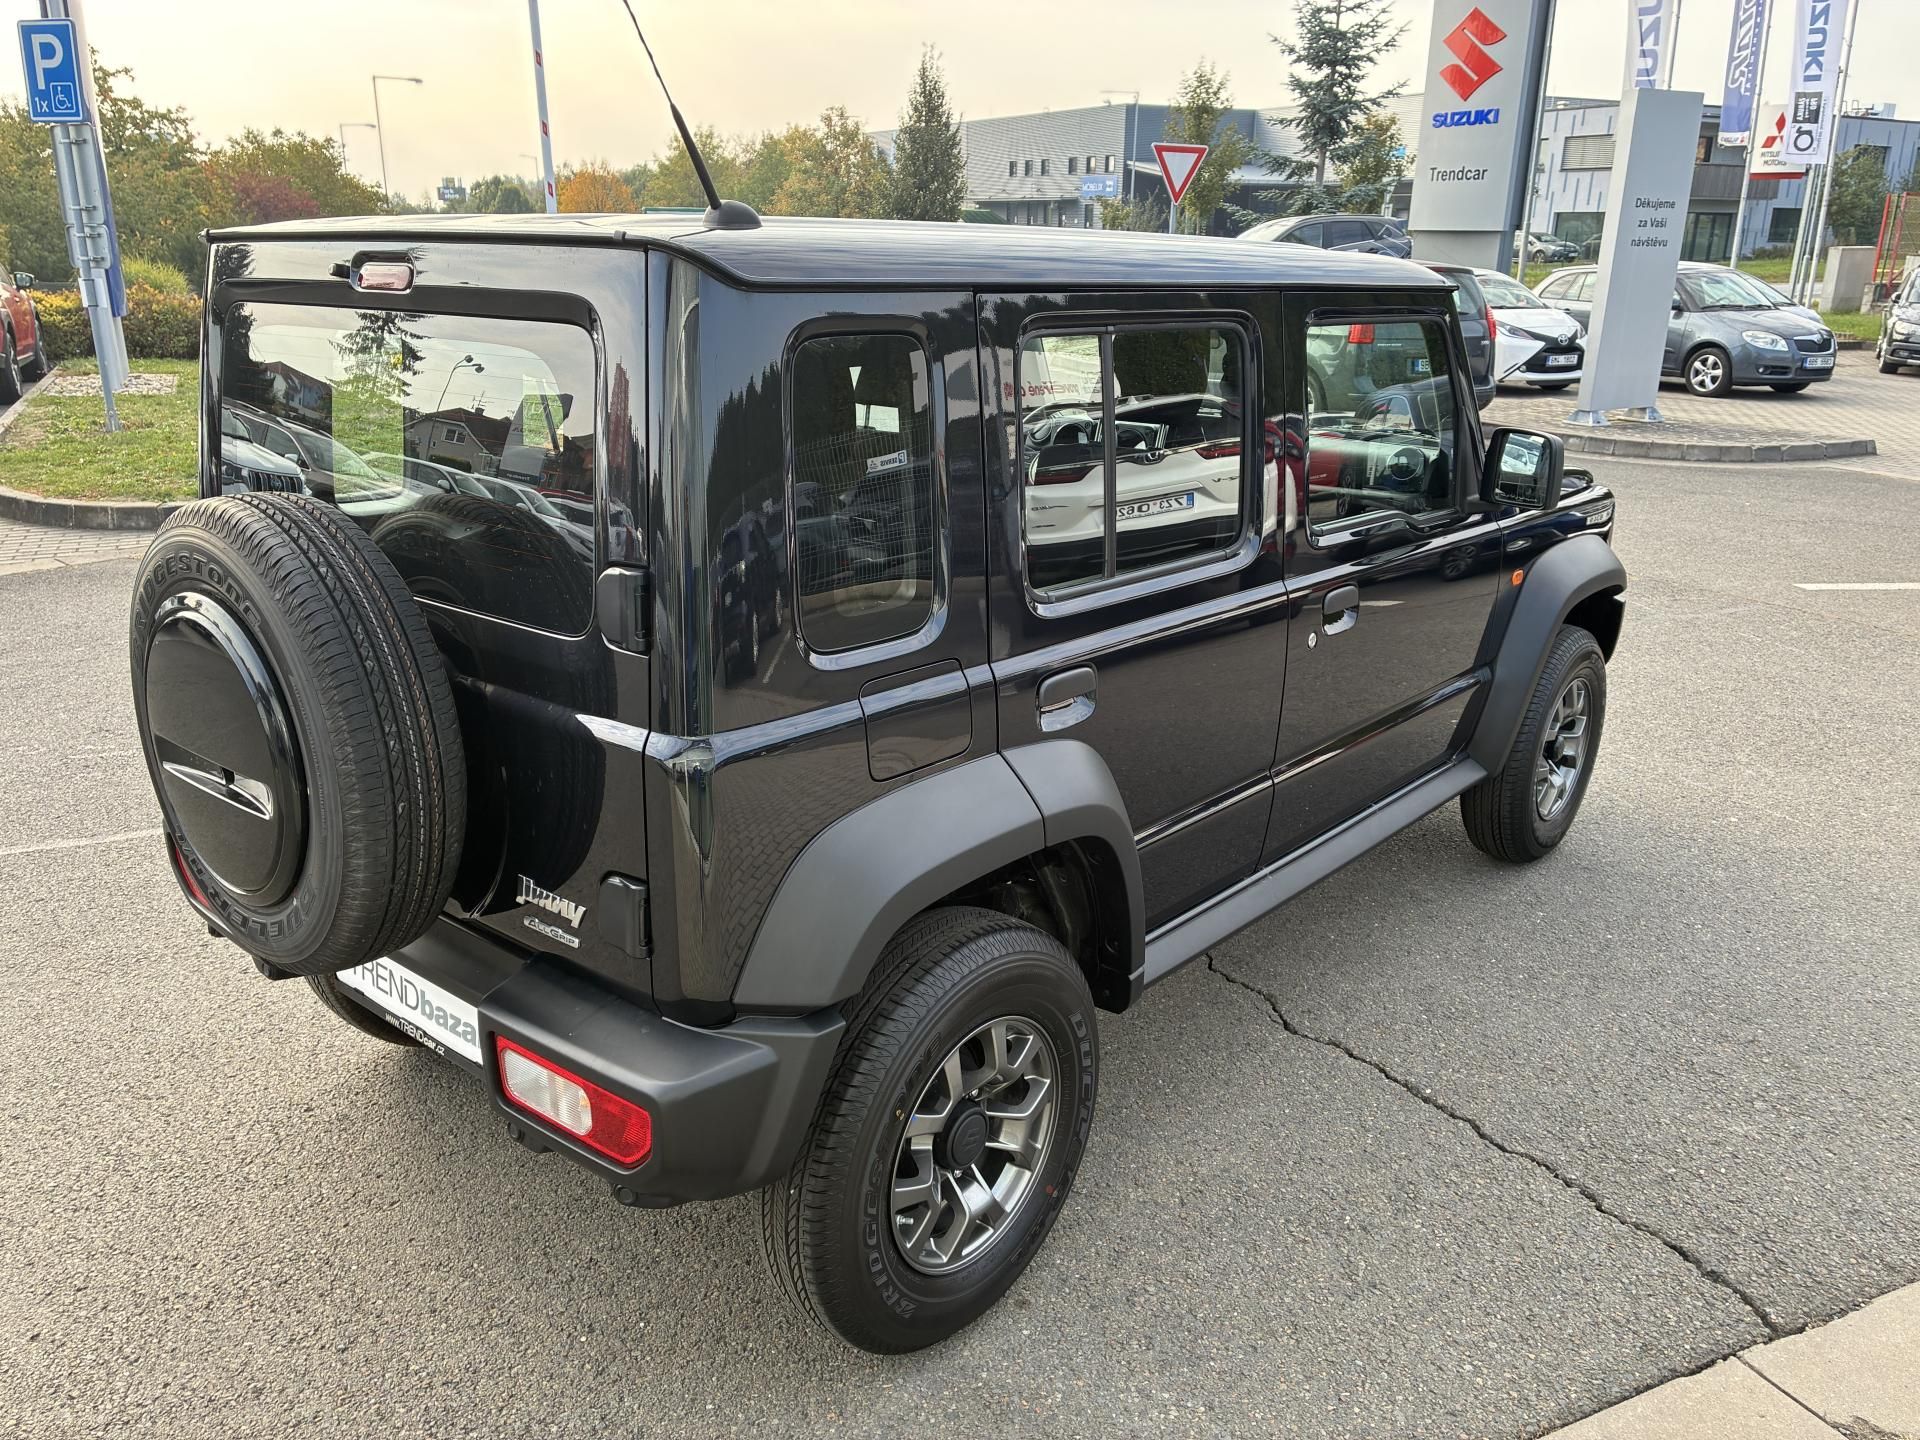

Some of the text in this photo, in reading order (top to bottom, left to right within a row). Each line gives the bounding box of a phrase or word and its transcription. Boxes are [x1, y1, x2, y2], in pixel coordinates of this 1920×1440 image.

[31, 33, 63, 90] P
[35, 97, 49, 112] 1x
[1432, 108, 1500, 128] SUZUKI
[1430, 165, 1488, 182] Trendcar
[1635, 197, 1676, 211] Děkujeme
[1638, 217, 1668, 228] za Vaši
[1631, 236, 1668, 247] návštěvu
[352, 959, 481, 1048] RENDbaza
